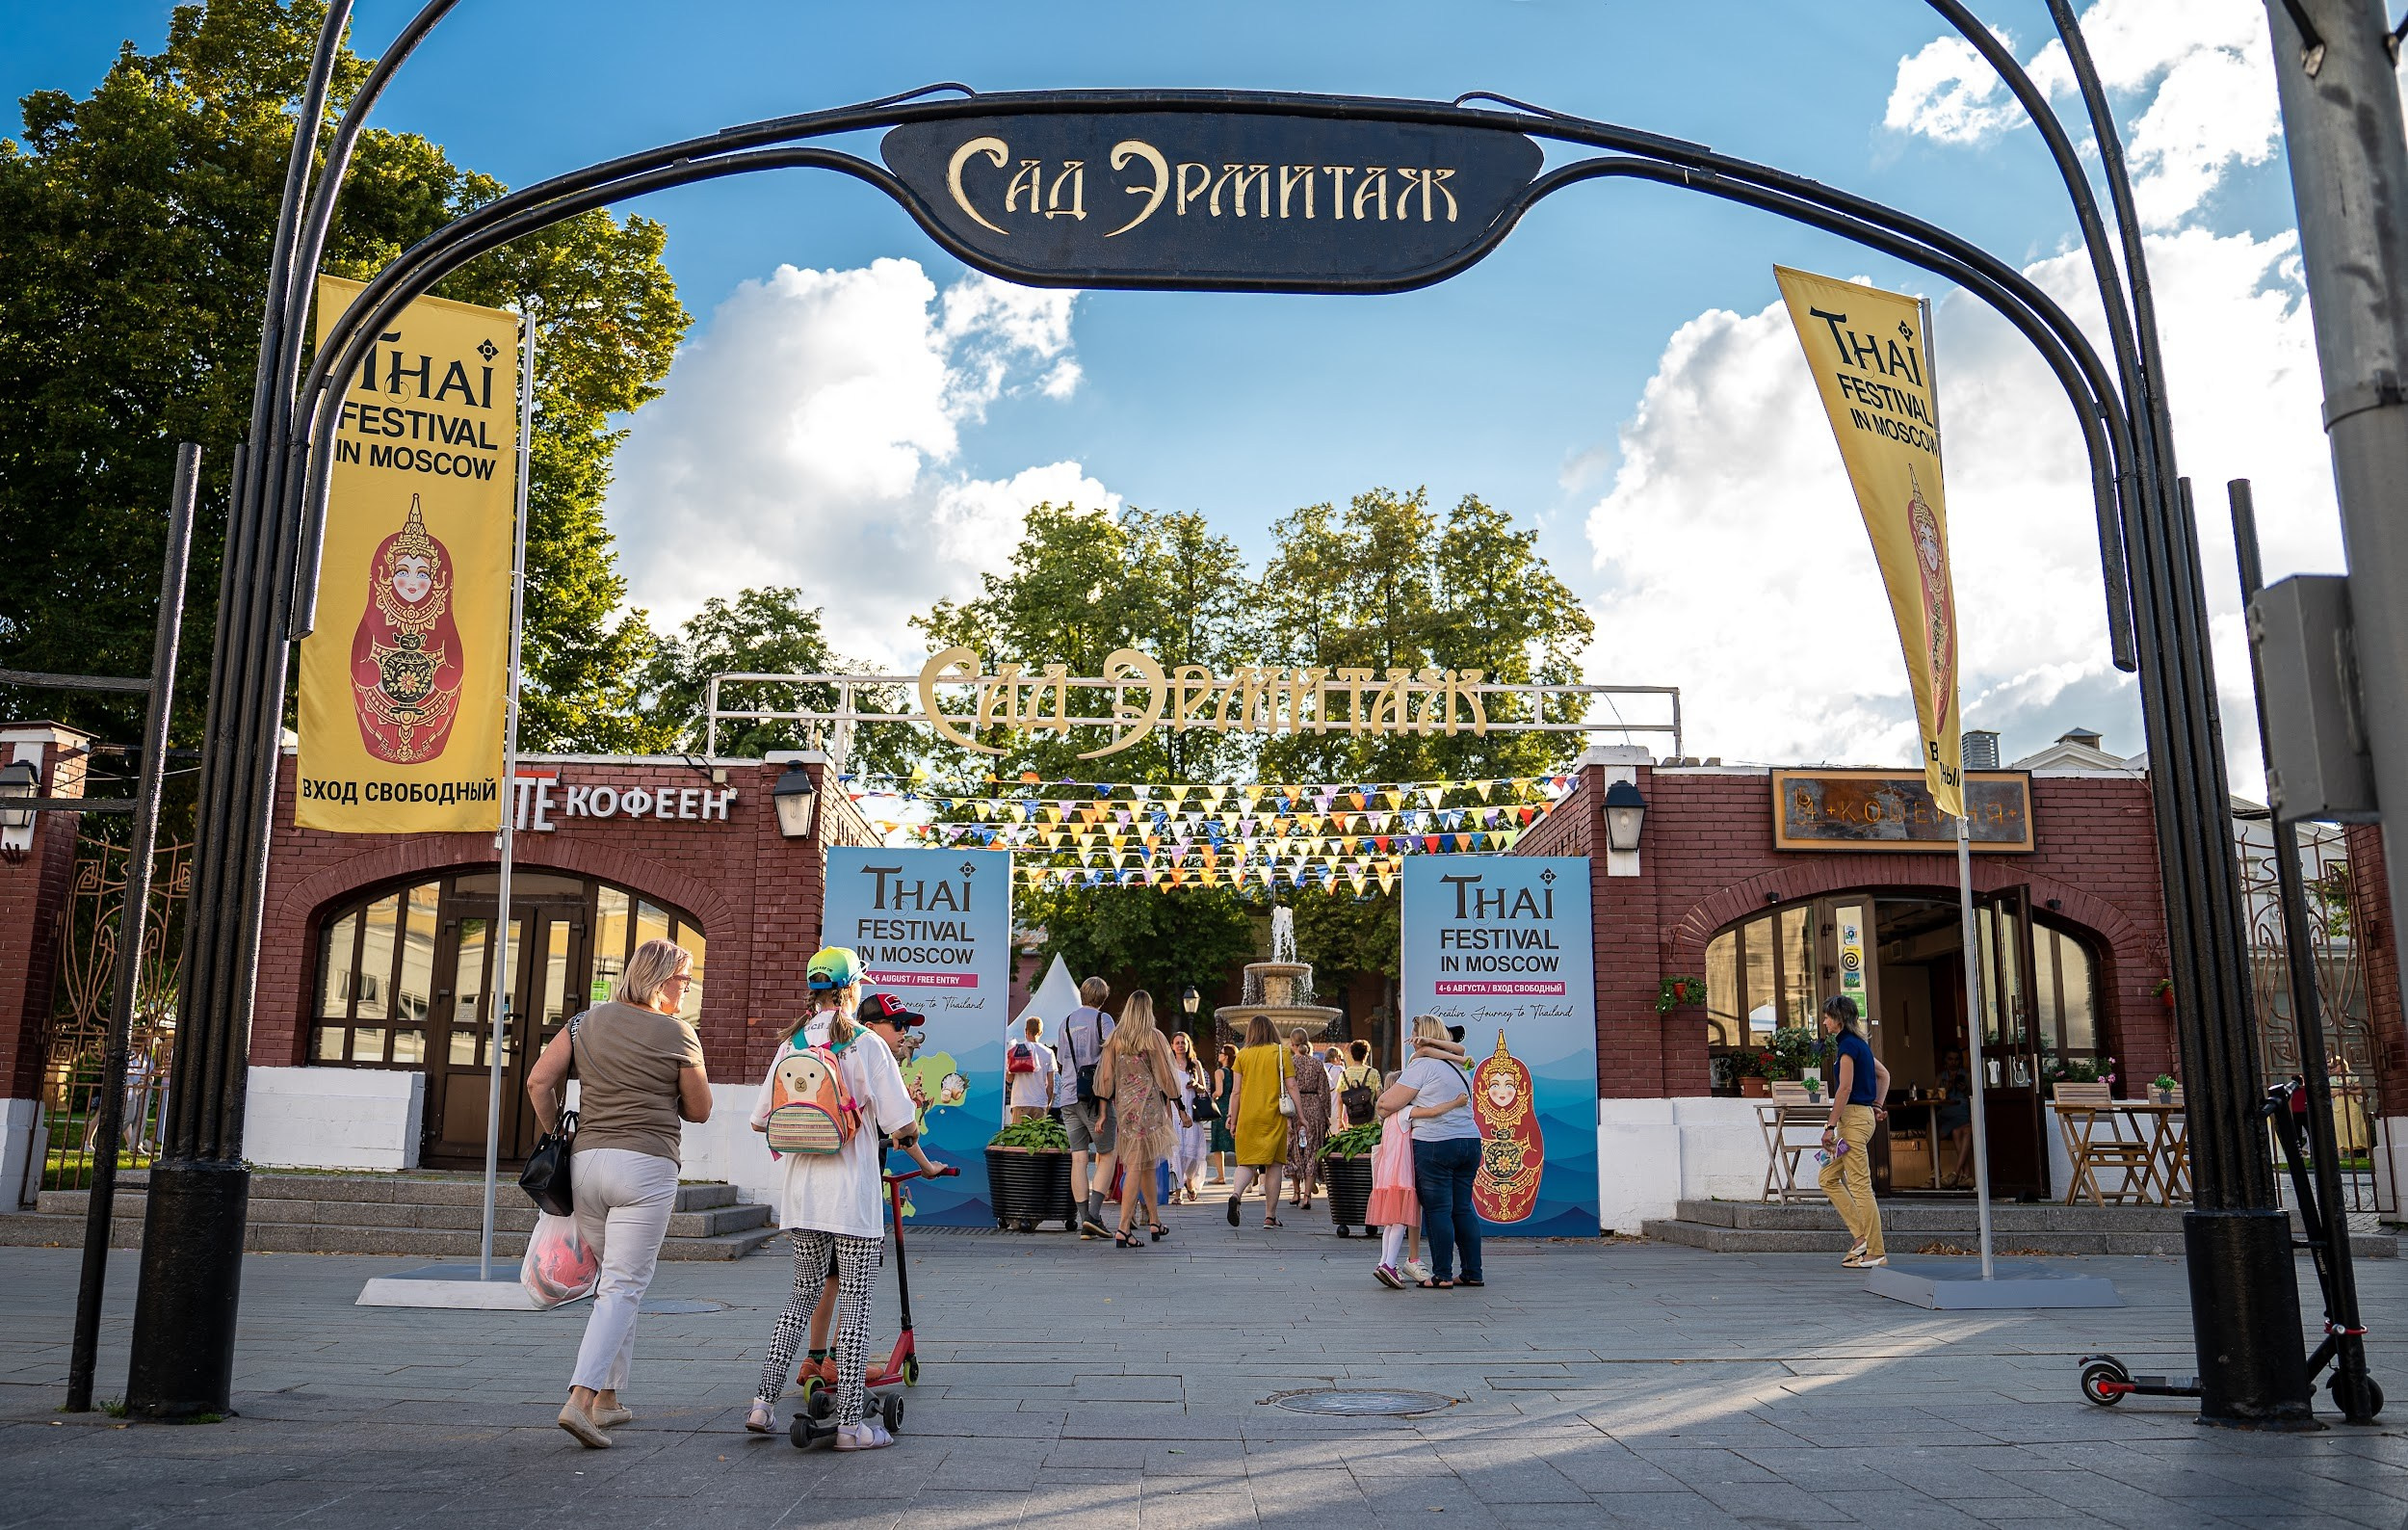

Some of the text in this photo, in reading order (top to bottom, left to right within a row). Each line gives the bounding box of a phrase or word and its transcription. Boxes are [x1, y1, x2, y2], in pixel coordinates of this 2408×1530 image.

[1809, 304, 1924, 388] THAI
[358, 330, 500, 409] THAI
[1836, 372, 1934, 430] FESTIVAL
[338, 401, 499, 451] FESTIVAL
[1849, 408, 1939, 459] IN MOSCOW
[335, 438, 497, 481] IN MOSCOW
[302, 778, 497, 806] ВХОД СВОБОДНЫЙ
[565, 785, 730, 821] КОФЕЕН
[860, 860, 977, 916] THAI
[1439, 867, 1557, 926] THAI
[857, 918, 976, 943] FESTIVAL
[1440, 929, 1559, 950] FESTIVAL
[856, 945, 975, 964] IN MOSCOW
[1441, 955, 1560, 973] IN MOSCOW
[881, 974, 911, 984] AUGUST
[917, 975, 935, 984] FREE
[935, 976, 960, 985] ENTRY
[1438, 984, 1452, 992] 4-6
[1453, 984, 1486, 993] АВГУСТА
[1492, 984, 1513, 994] ВХОД
[1514, 982, 1562, 994] СВОБОДНЫЙ
[903, 994, 986, 1013] rney to Thailand
[1428, 1003, 1574, 1022] Creative Journey to Thailand
